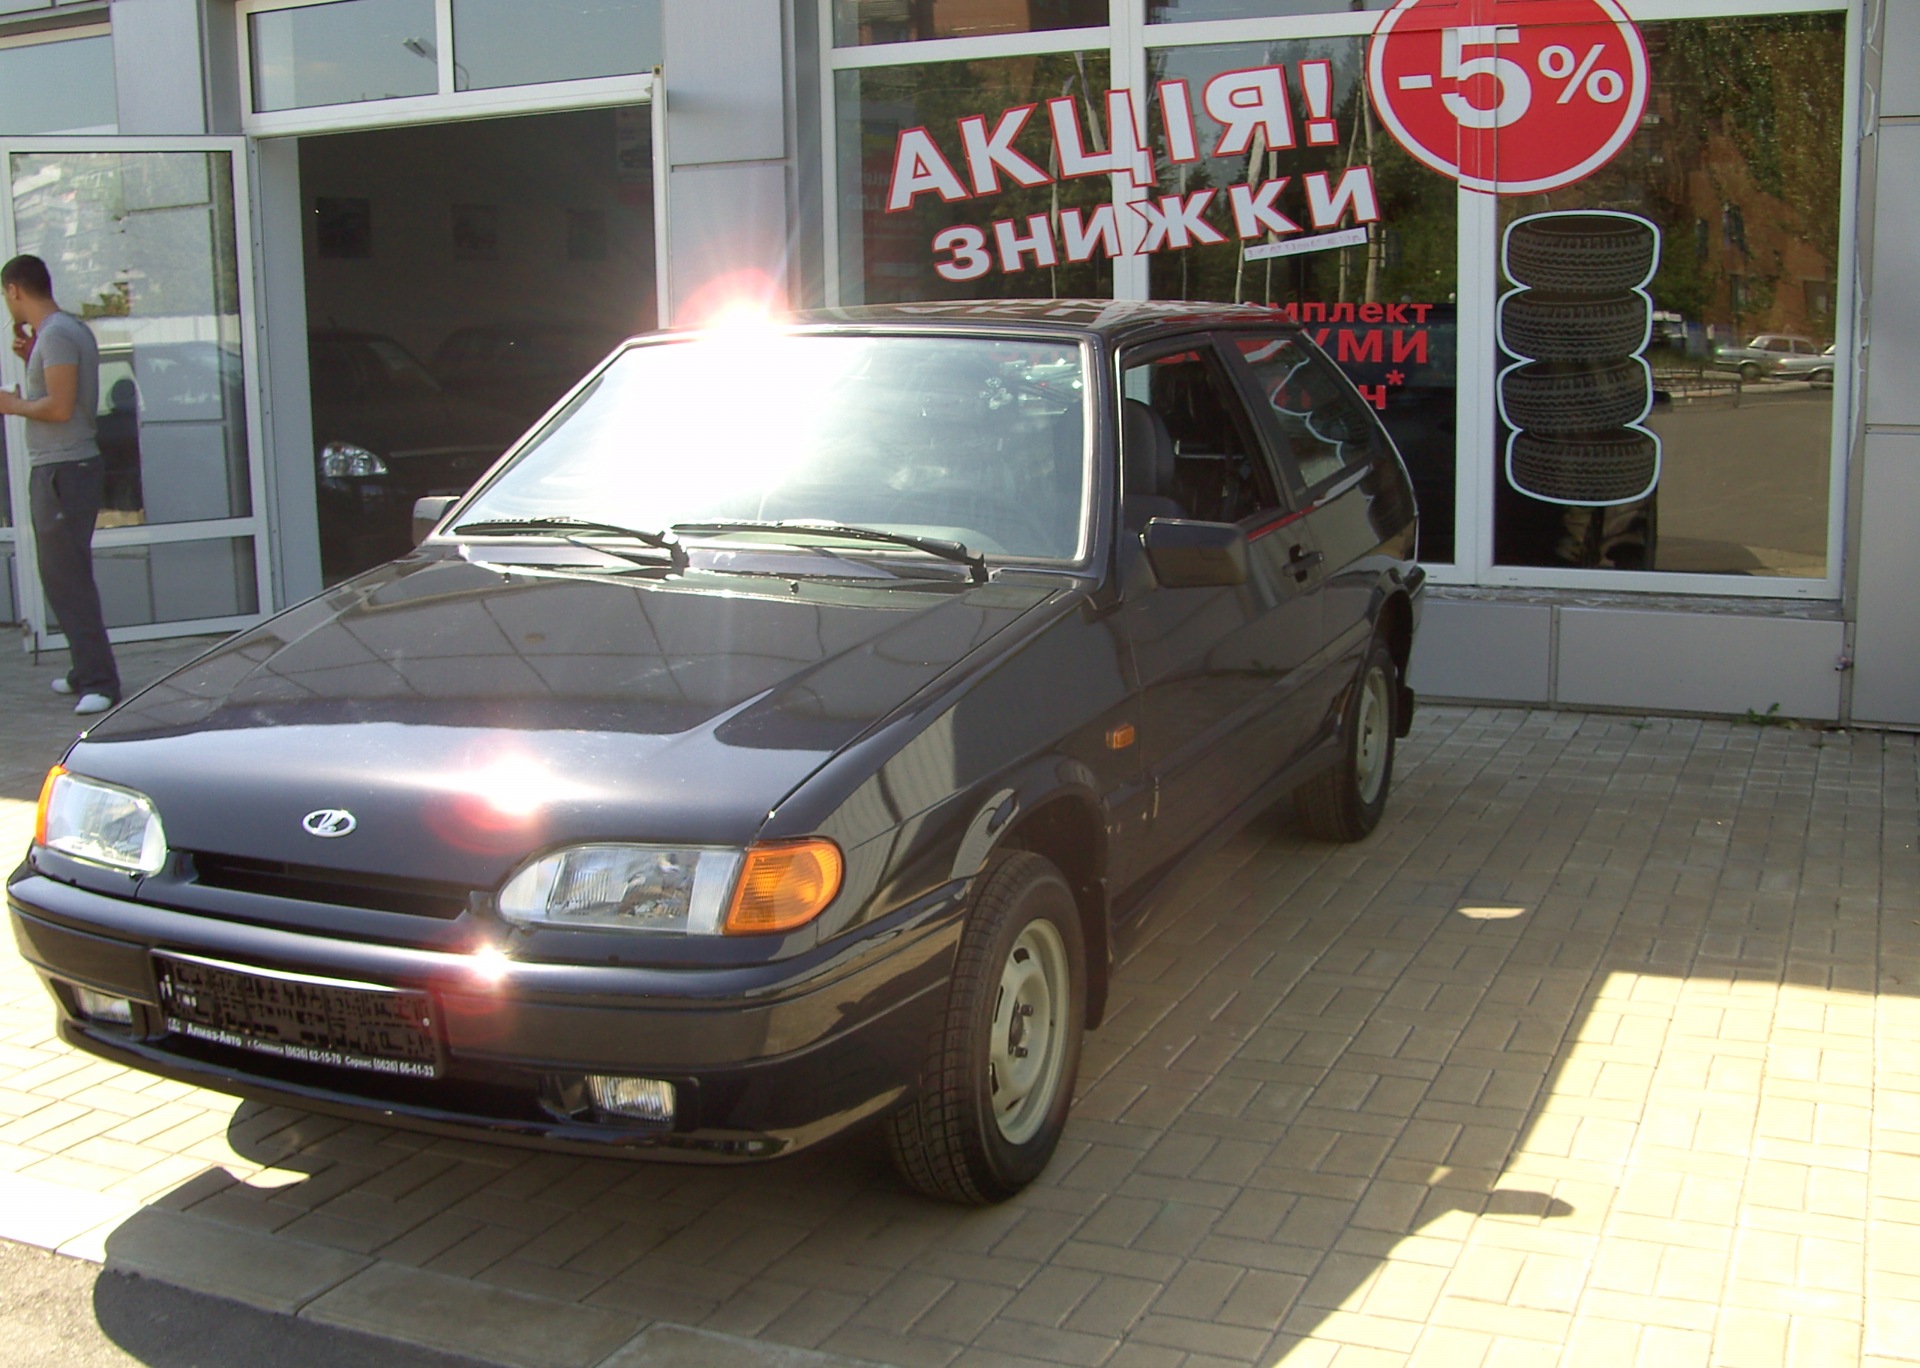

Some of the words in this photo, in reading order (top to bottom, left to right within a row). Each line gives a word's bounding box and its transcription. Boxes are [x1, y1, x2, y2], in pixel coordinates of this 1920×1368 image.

[1398, 24, 1624, 129] -5%
[885, 59, 1339, 213] АКЦІЯ!
[1246, 301, 1433, 324] мплект
